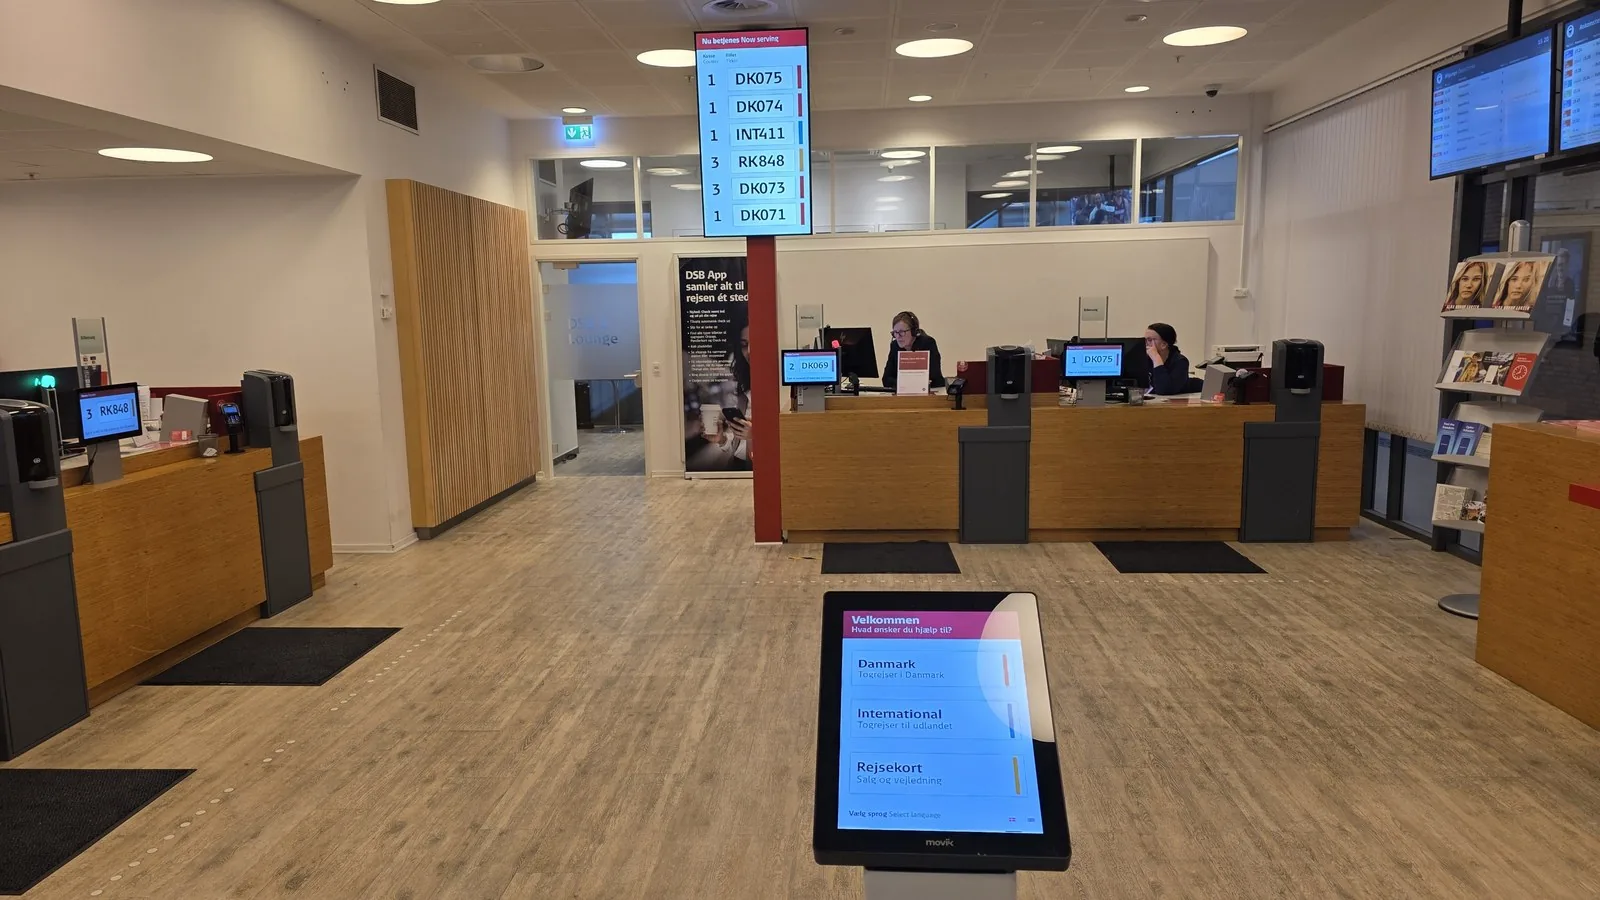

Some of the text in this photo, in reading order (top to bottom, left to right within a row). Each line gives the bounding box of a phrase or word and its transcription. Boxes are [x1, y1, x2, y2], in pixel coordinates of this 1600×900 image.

[713, 37, 740, 45] betjenes
[757, 35, 779, 43] serving
[708, 72, 782, 86] 1 DK075
[709, 100, 783, 114] 1 DK074
[711, 127, 785, 141] 1 INT411
[712, 155, 785, 169] 3 RK848
[712, 182, 785, 196] 3 DK073
[714, 209, 786, 222] 1 DK071
[685, 270, 727, 281] DSB App
[685, 280, 745, 291] samler alt til
[686, 293, 749, 304] rejsen ét sted
[568, 333, 619, 347] Lounge
[1084, 355, 1113, 364] DK075
[789, 361, 829, 371] 2 DK069
[86, 402, 129, 420] 3 RK848
[851, 615, 920, 625] Velkommen
[851, 626, 953, 635] Hvad ønsker du hjælp til?
[858, 659, 916, 669] Danmark
[858, 670, 897, 679] Togrejser
[905, 671, 945, 679] Danmark
[857, 708, 942, 720] International
[857, 720, 953, 730] Togrejser til udlandet
[857, 761, 923, 775] Rejsekort
[857, 775, 943, 786] Salg og vejledning
[848, 810, 866, 818] Vælg
